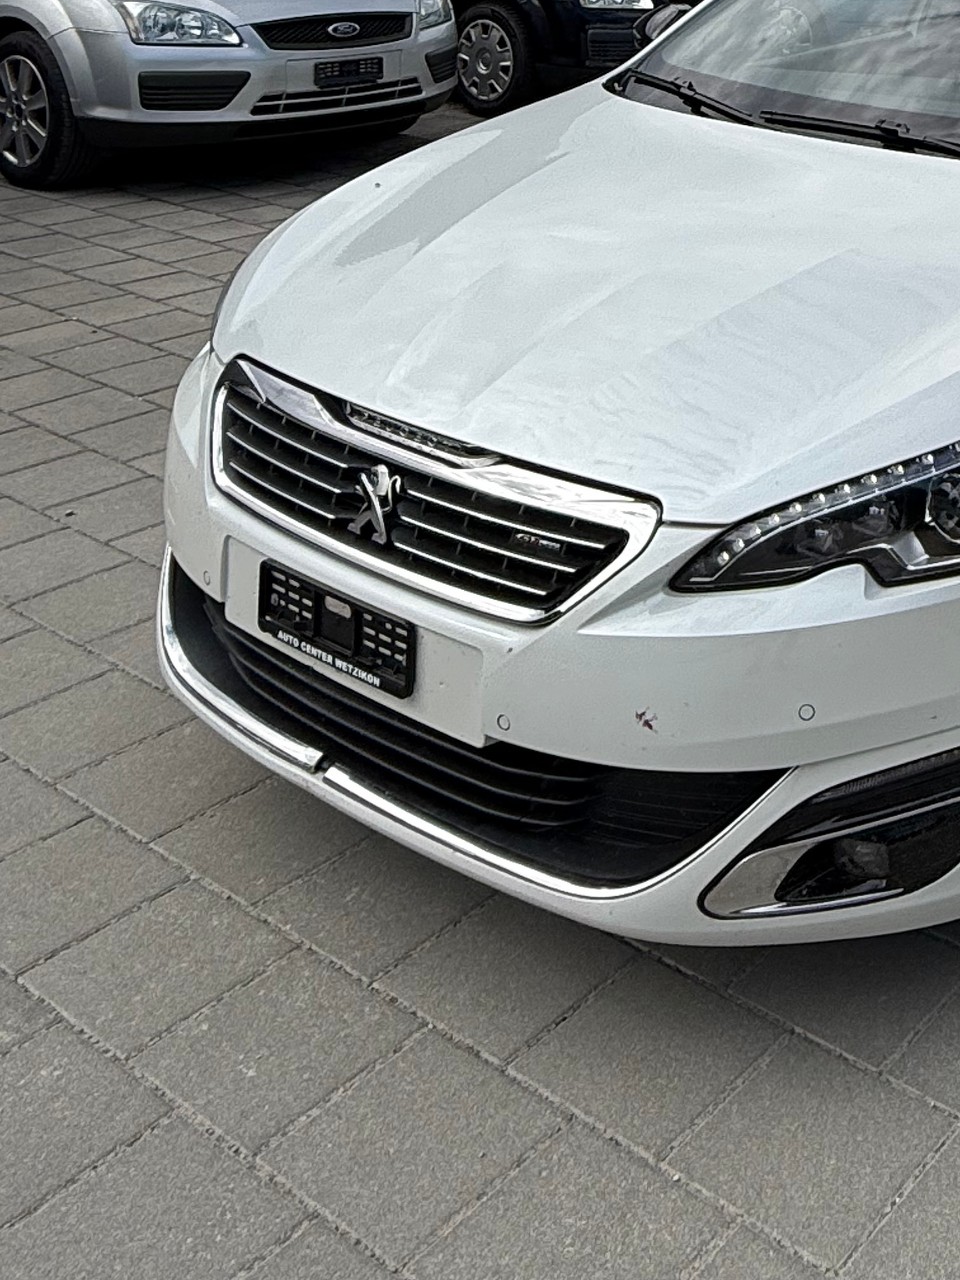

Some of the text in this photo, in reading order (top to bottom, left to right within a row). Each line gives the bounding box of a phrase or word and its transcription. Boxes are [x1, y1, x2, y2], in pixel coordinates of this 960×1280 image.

[277, 629, 381, 687] AUTO CENTER WETZIKON
